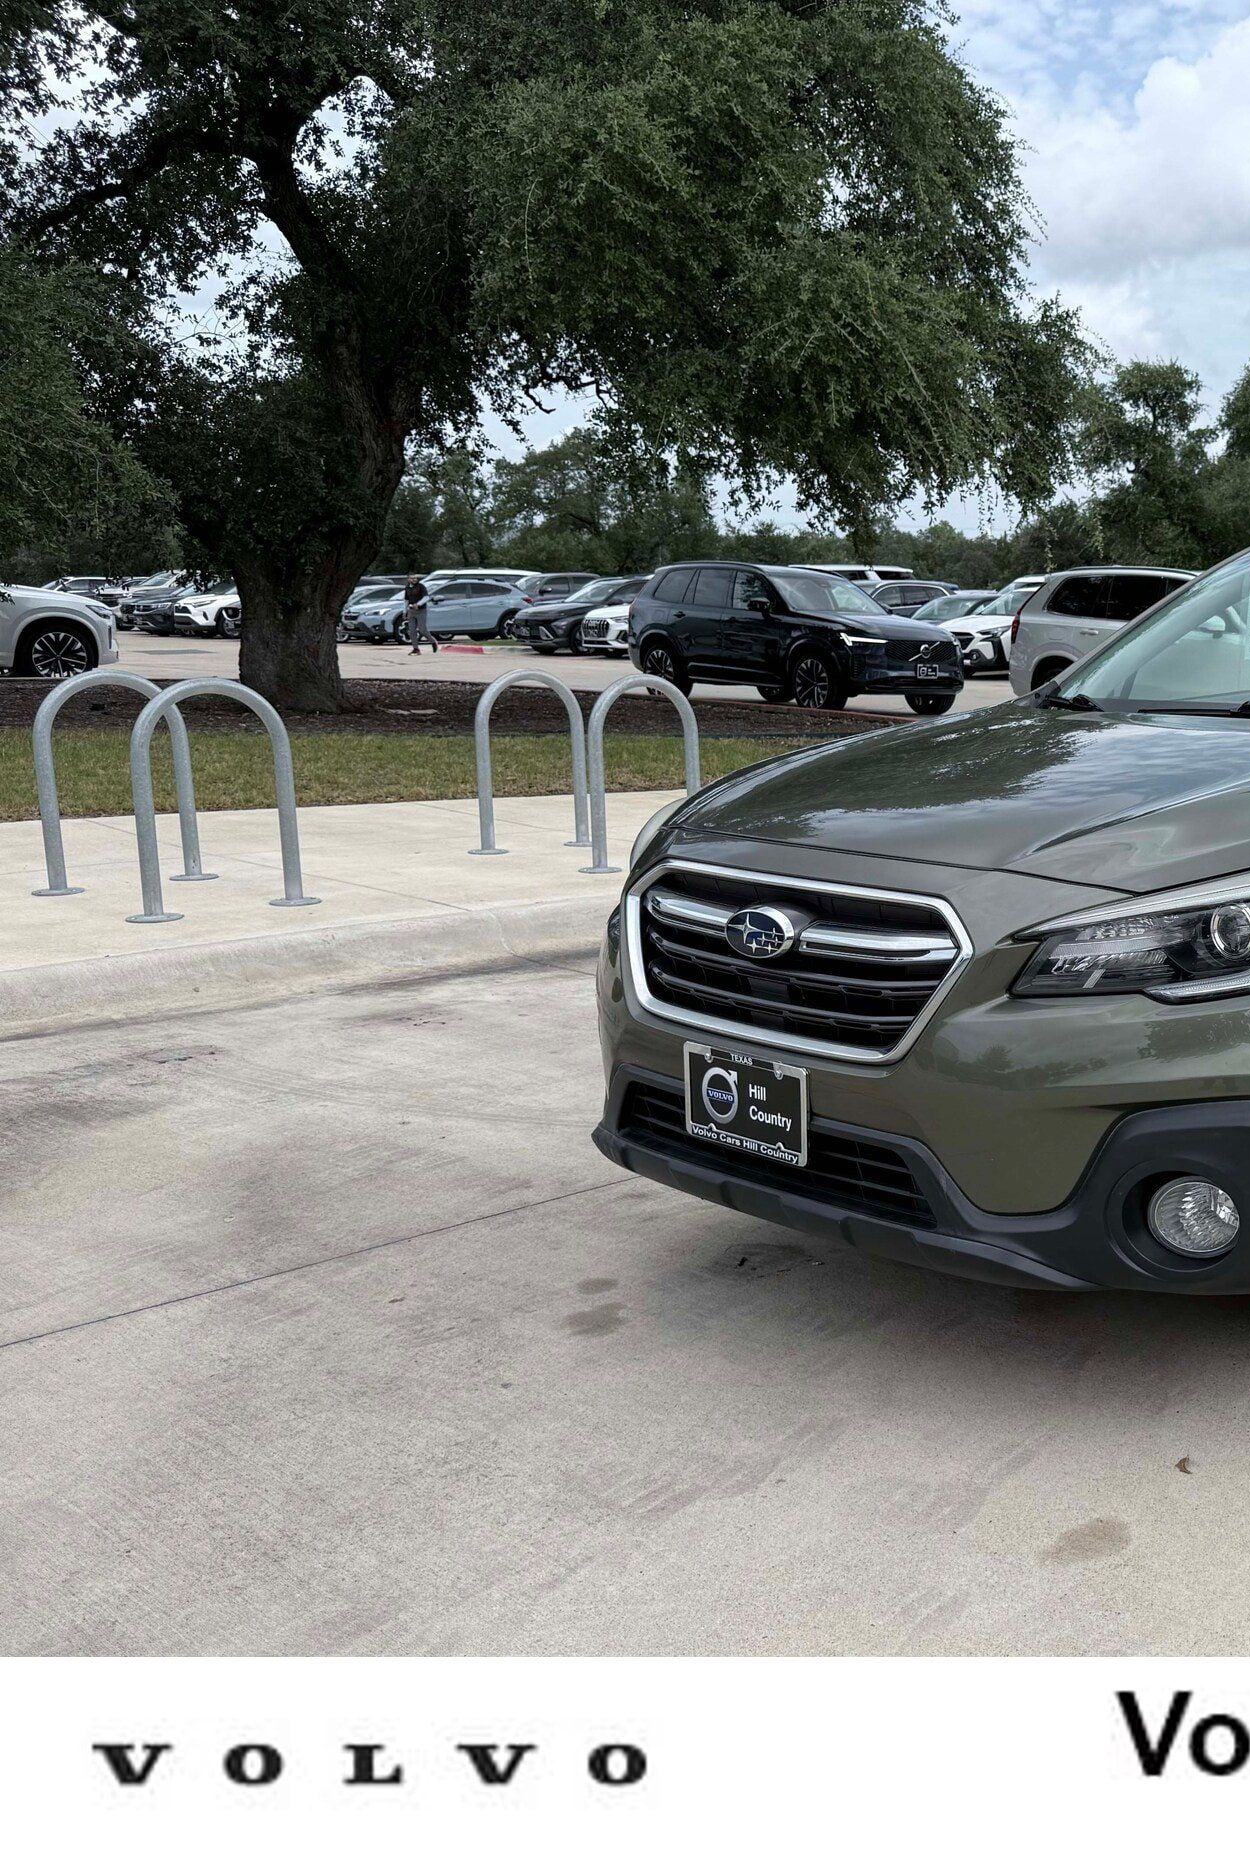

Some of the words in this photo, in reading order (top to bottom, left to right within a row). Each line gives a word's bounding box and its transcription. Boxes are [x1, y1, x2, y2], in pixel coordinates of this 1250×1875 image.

[730, 1053, 753, 1065] TEXAS
[707, 1089, 734, 1102] VOLVO
[749, 1083, 767, 1101] Hill
[749, 1105, 792, 1132] Country
[692, 1125, 718, 1140] Volvo
[719, 1132, 741, 1146] Cars
[743, 1140, 758, 1152] Hill
[760, 1144, 798, 1165] Country
